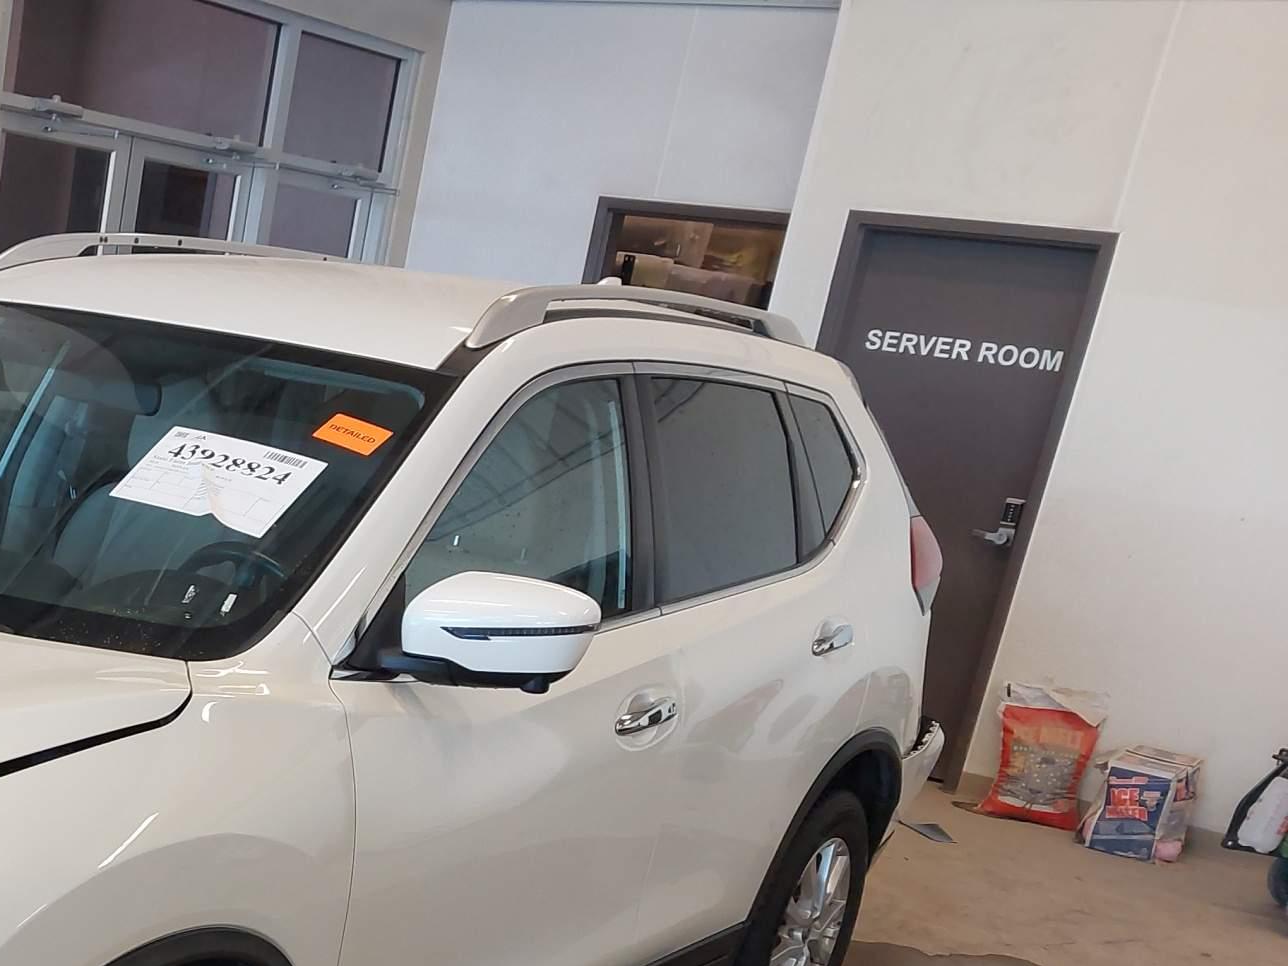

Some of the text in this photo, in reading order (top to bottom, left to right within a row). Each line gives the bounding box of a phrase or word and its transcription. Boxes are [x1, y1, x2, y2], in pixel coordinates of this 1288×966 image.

[865, 329, 1064, 372] SERVER ROOM
[329, 424, 376, 444] DETAILED
[168, 443, 292, 485] 43928824
